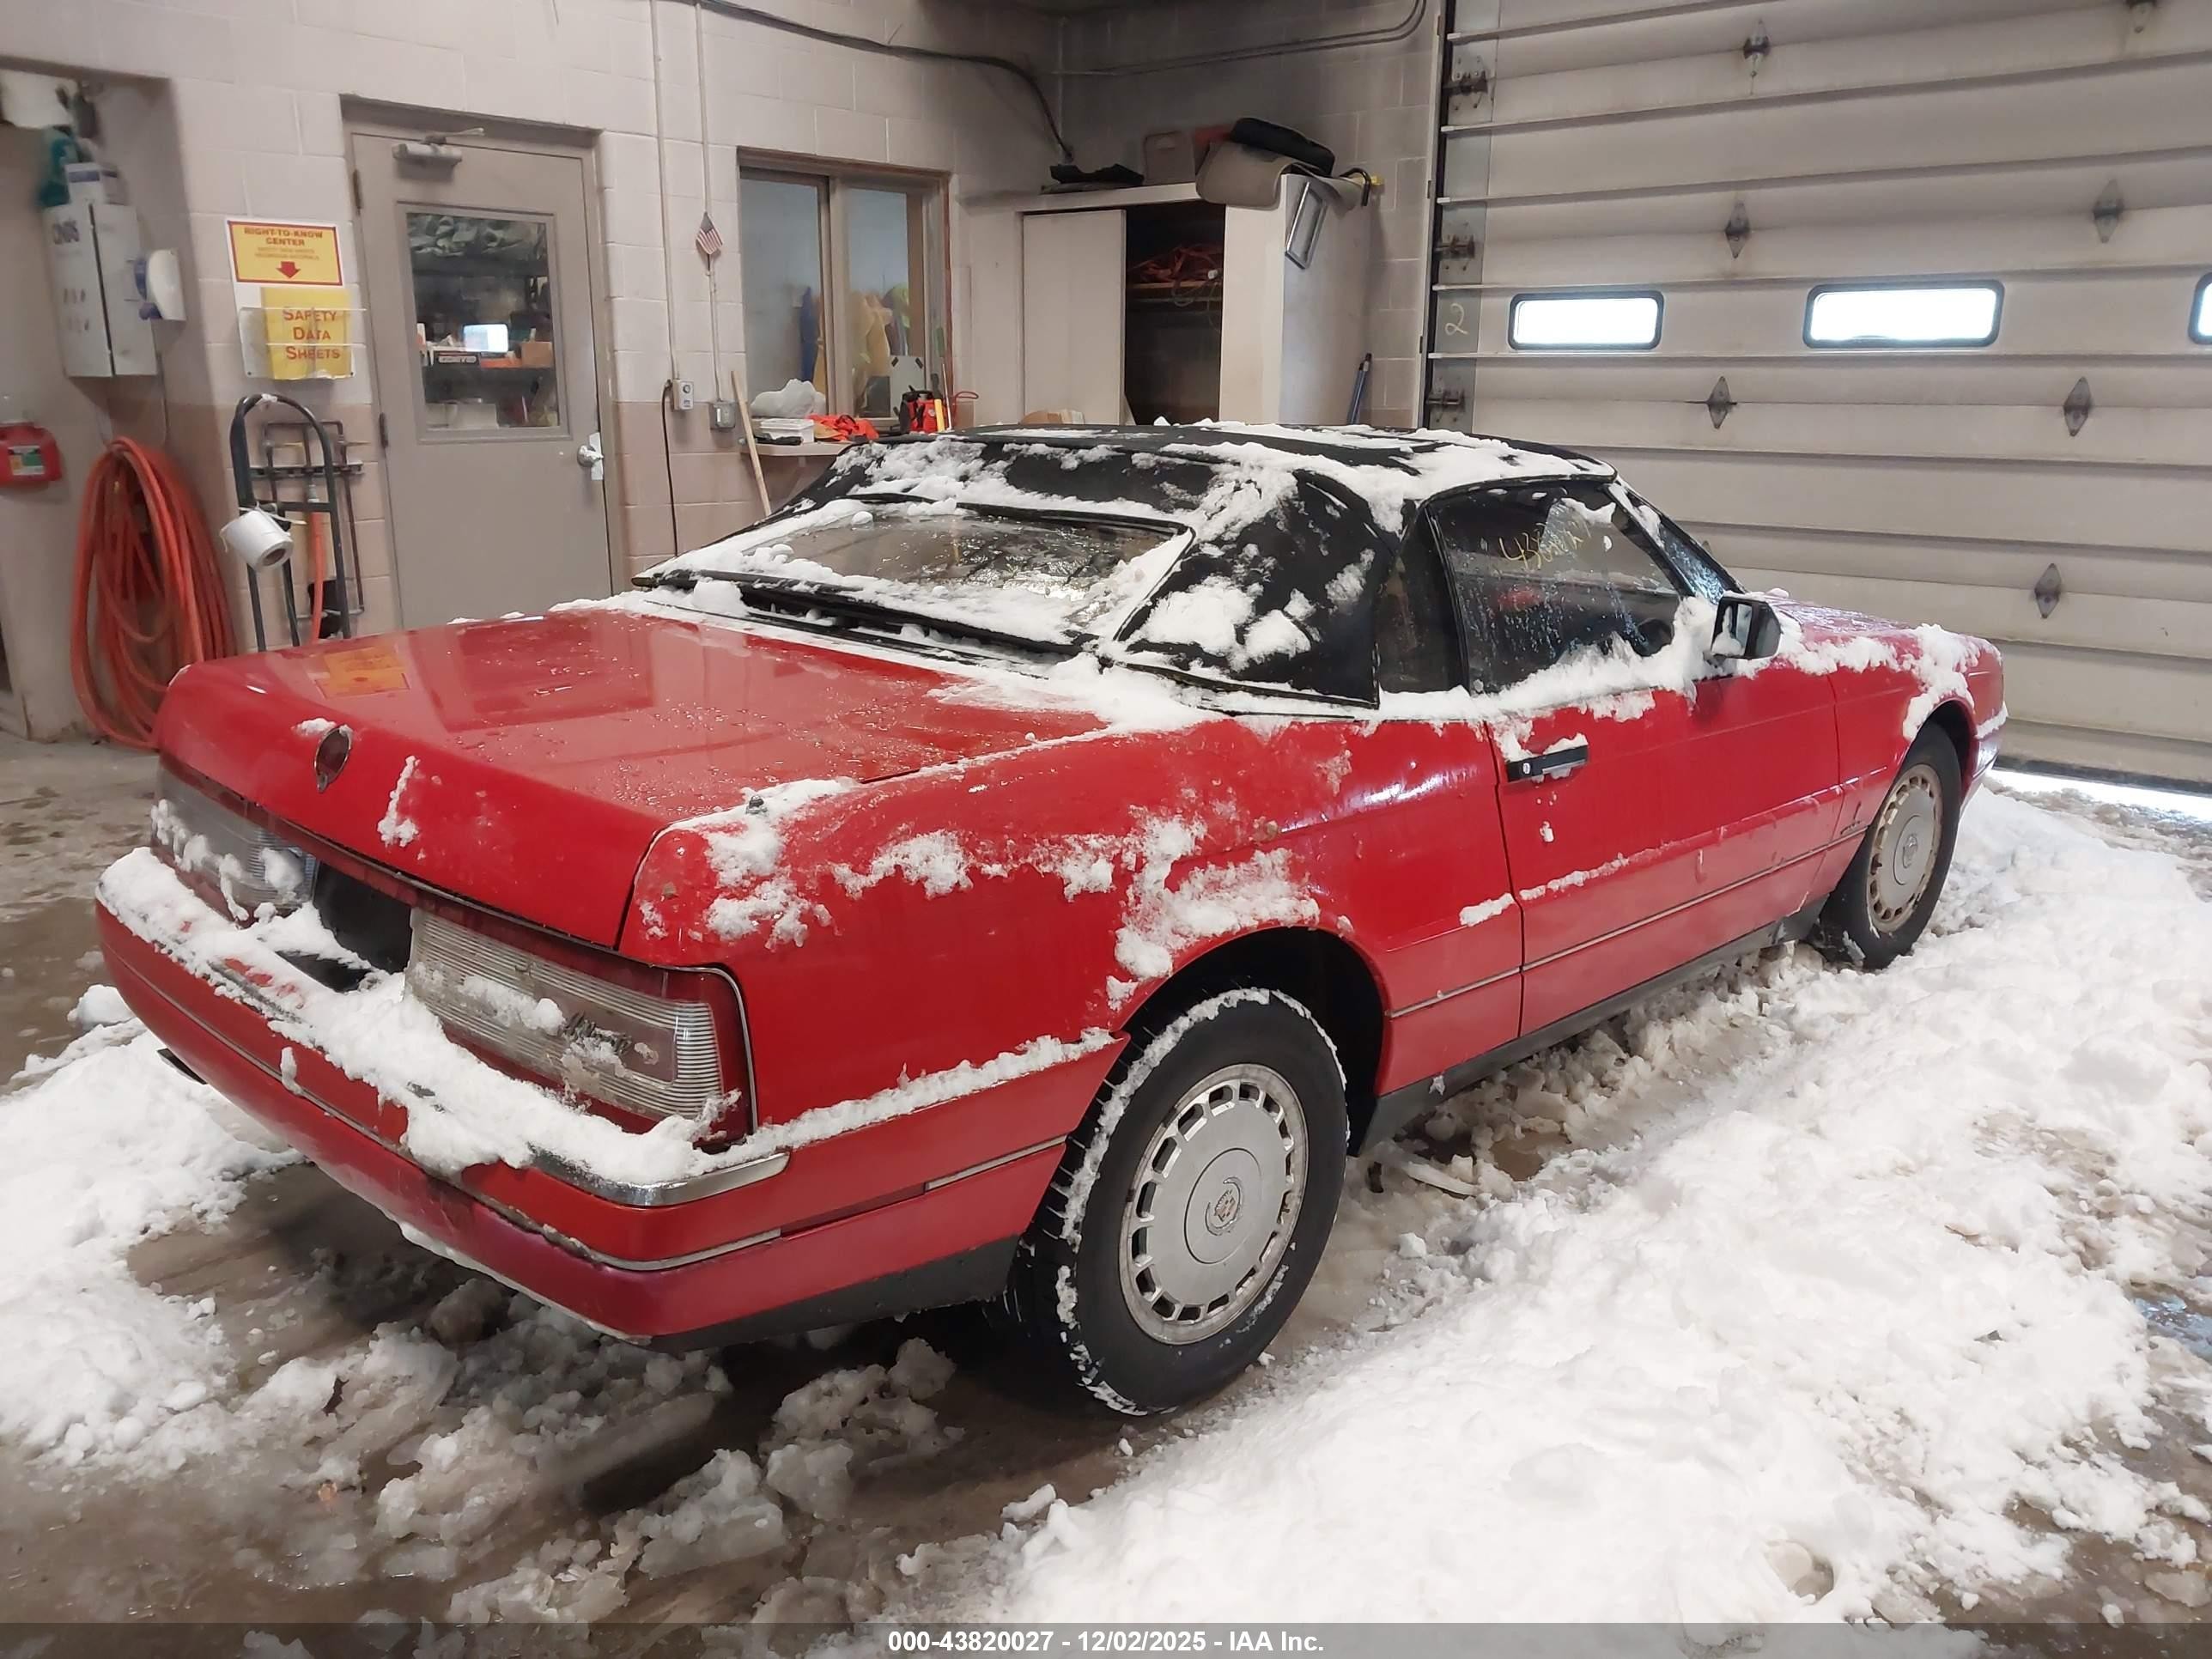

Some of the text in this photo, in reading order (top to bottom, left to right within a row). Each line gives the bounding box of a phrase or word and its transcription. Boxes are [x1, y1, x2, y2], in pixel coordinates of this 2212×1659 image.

[244, 227, 323, 239] RIGHT-TO-KNOW
[265, 237, 305, 246] CENTER
[282, 307, 337, 322] SAFETY
[1444, 302, 1468, 336] 2
[293, 326, 331, 341] DATA
[285, 346, 341, 360] SHEETS
